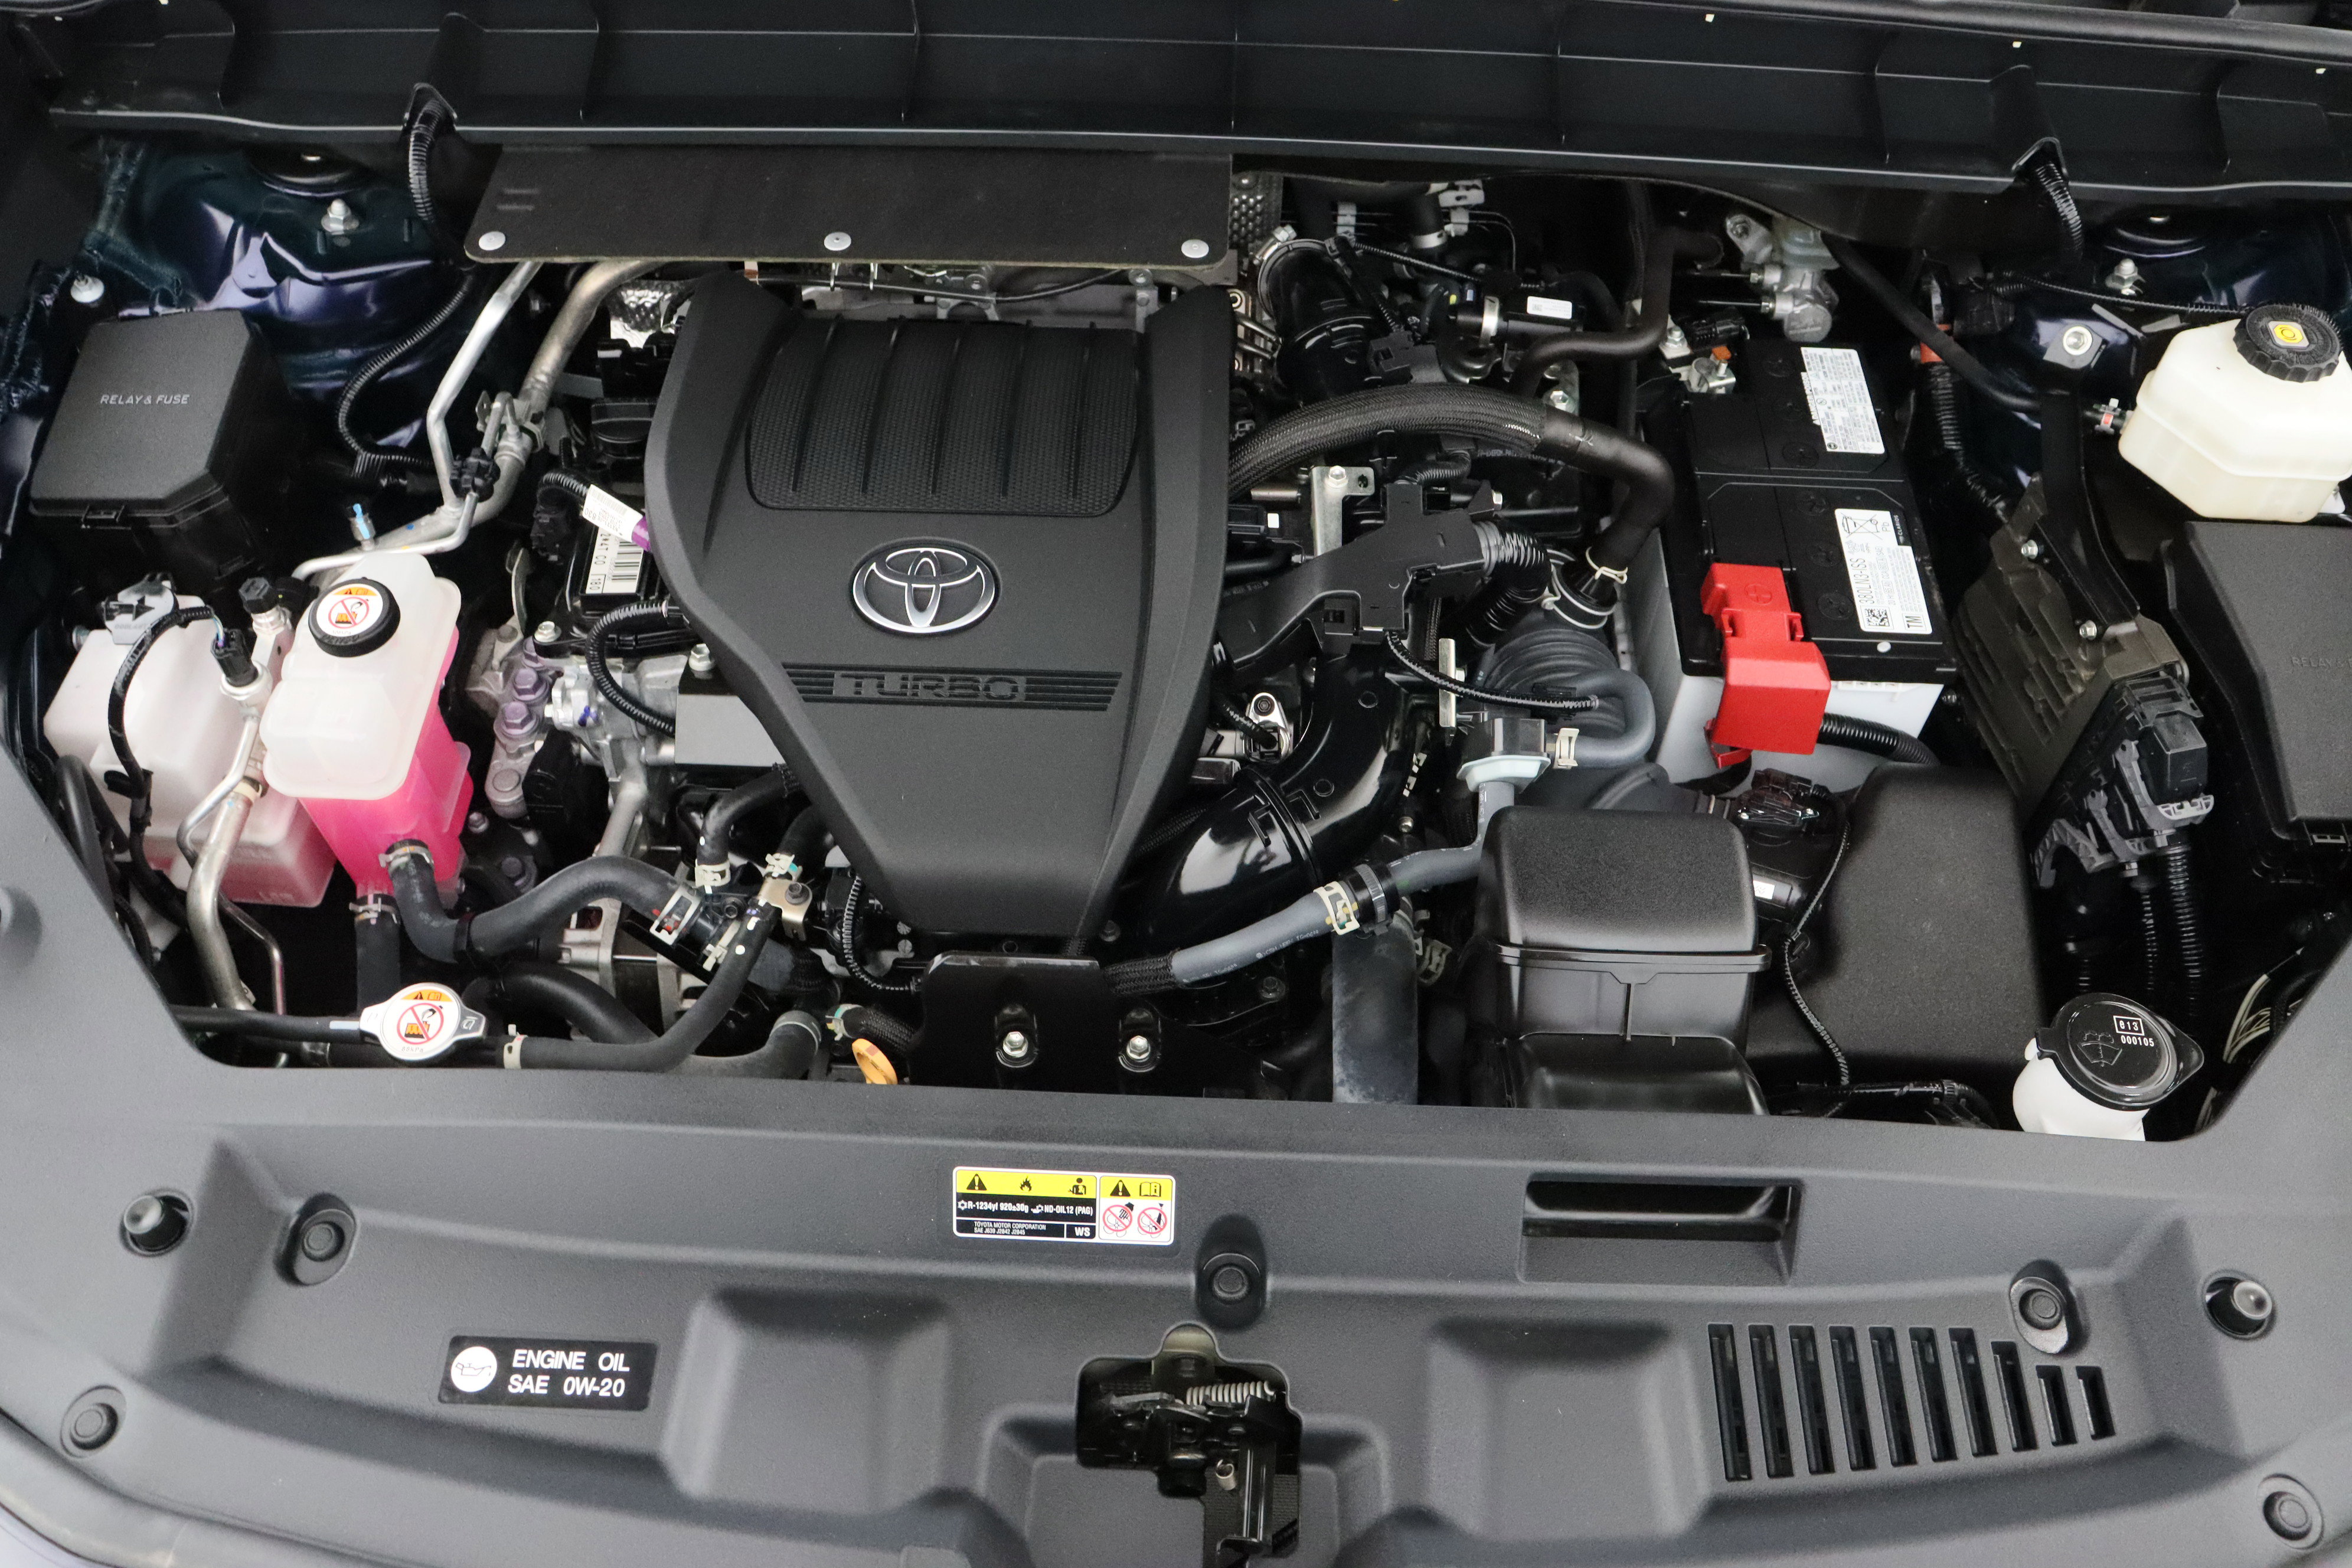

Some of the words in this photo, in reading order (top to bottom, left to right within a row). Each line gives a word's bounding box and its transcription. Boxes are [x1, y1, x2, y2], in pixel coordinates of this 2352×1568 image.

[100, 394, 143, 404] RELAY
[156, 394, 190, 404] FUSE
[1881, 521, 1890, 532] Pb
[1893, 514, 1903, 535] CLARIOS
[1849, 557, 1875, 605] 380LN3-ISS
[1905, 615, 1923, 629] TM
[2291, 657, 2331, 668] RELAY
[840, 672, 1020, 701] TURBO
[2119, 1020, 2139, 1031] e13
[2121, 1035, 2154, 1047] 000105
[967, 1201, 998, 1212] R-1234yf
[999, 1203, 1029, 1213] 920±30g
[1044, 1204, 1074, 1214] ND-OIL12
[1074, 1206, 1093, 1216] (PAG)
[1074, 1227, 1090, 1237] WS
[512, 1348, 586, 1370] ENGINE
[598, 1351, 631, 1373] OIL
[508, 1374, 550, 1394] SAE
[563, 1376, 626, 1397] 0W-20
